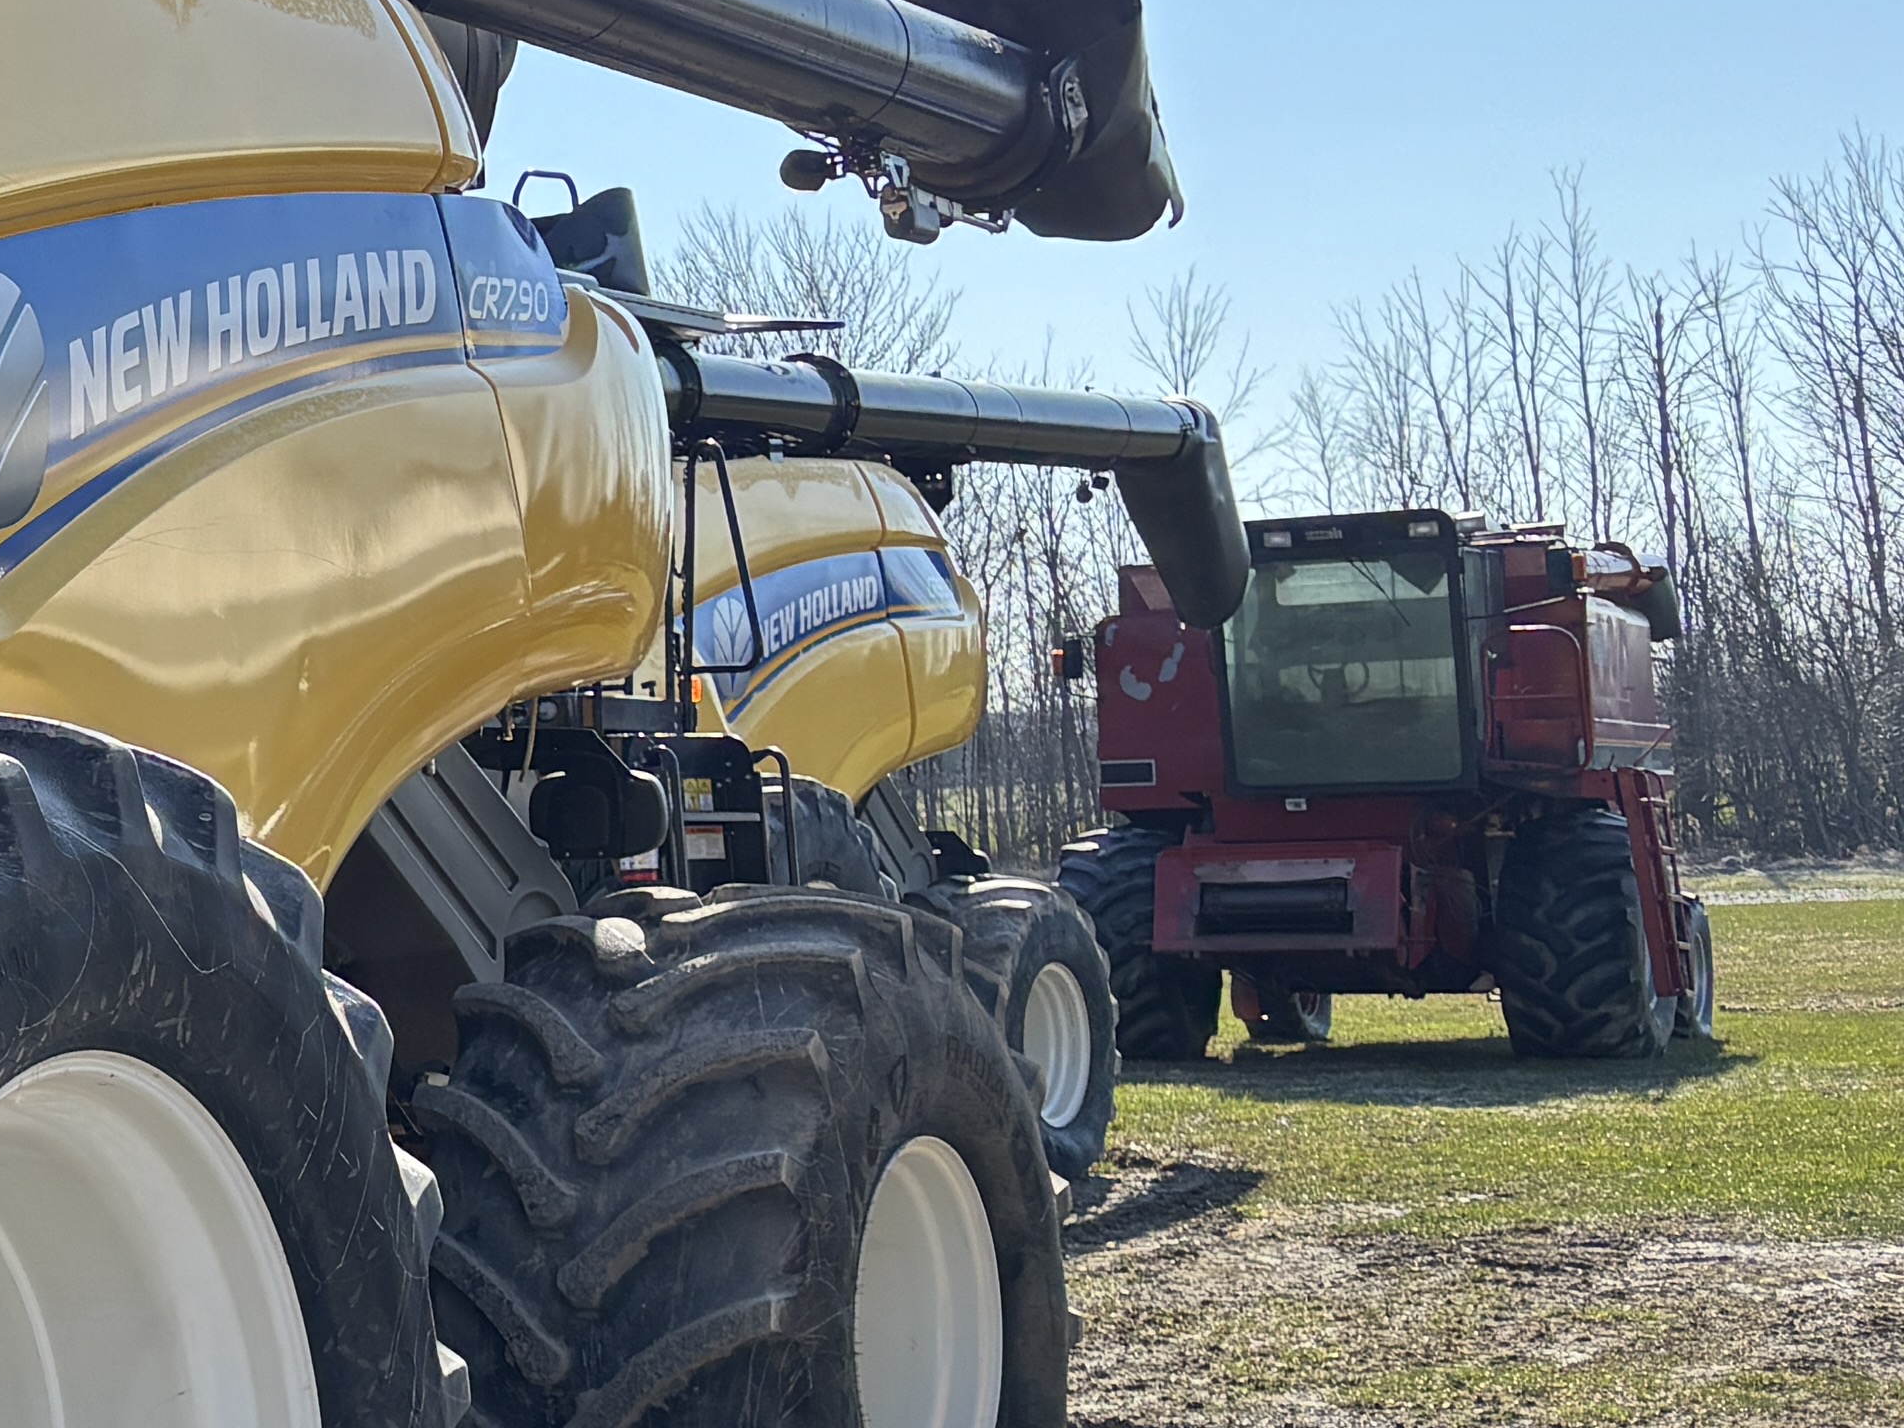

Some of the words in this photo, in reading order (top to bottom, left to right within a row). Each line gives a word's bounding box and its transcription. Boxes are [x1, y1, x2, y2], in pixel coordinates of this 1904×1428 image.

[468, 275, 549, 322] CR7.90
[69, 289, 192, 440] NEW
[206, 249, 437, 373] HOLLAND
[760, 601, 796, 659] NEW
[799, 575, 879, 634] HOLLAND
